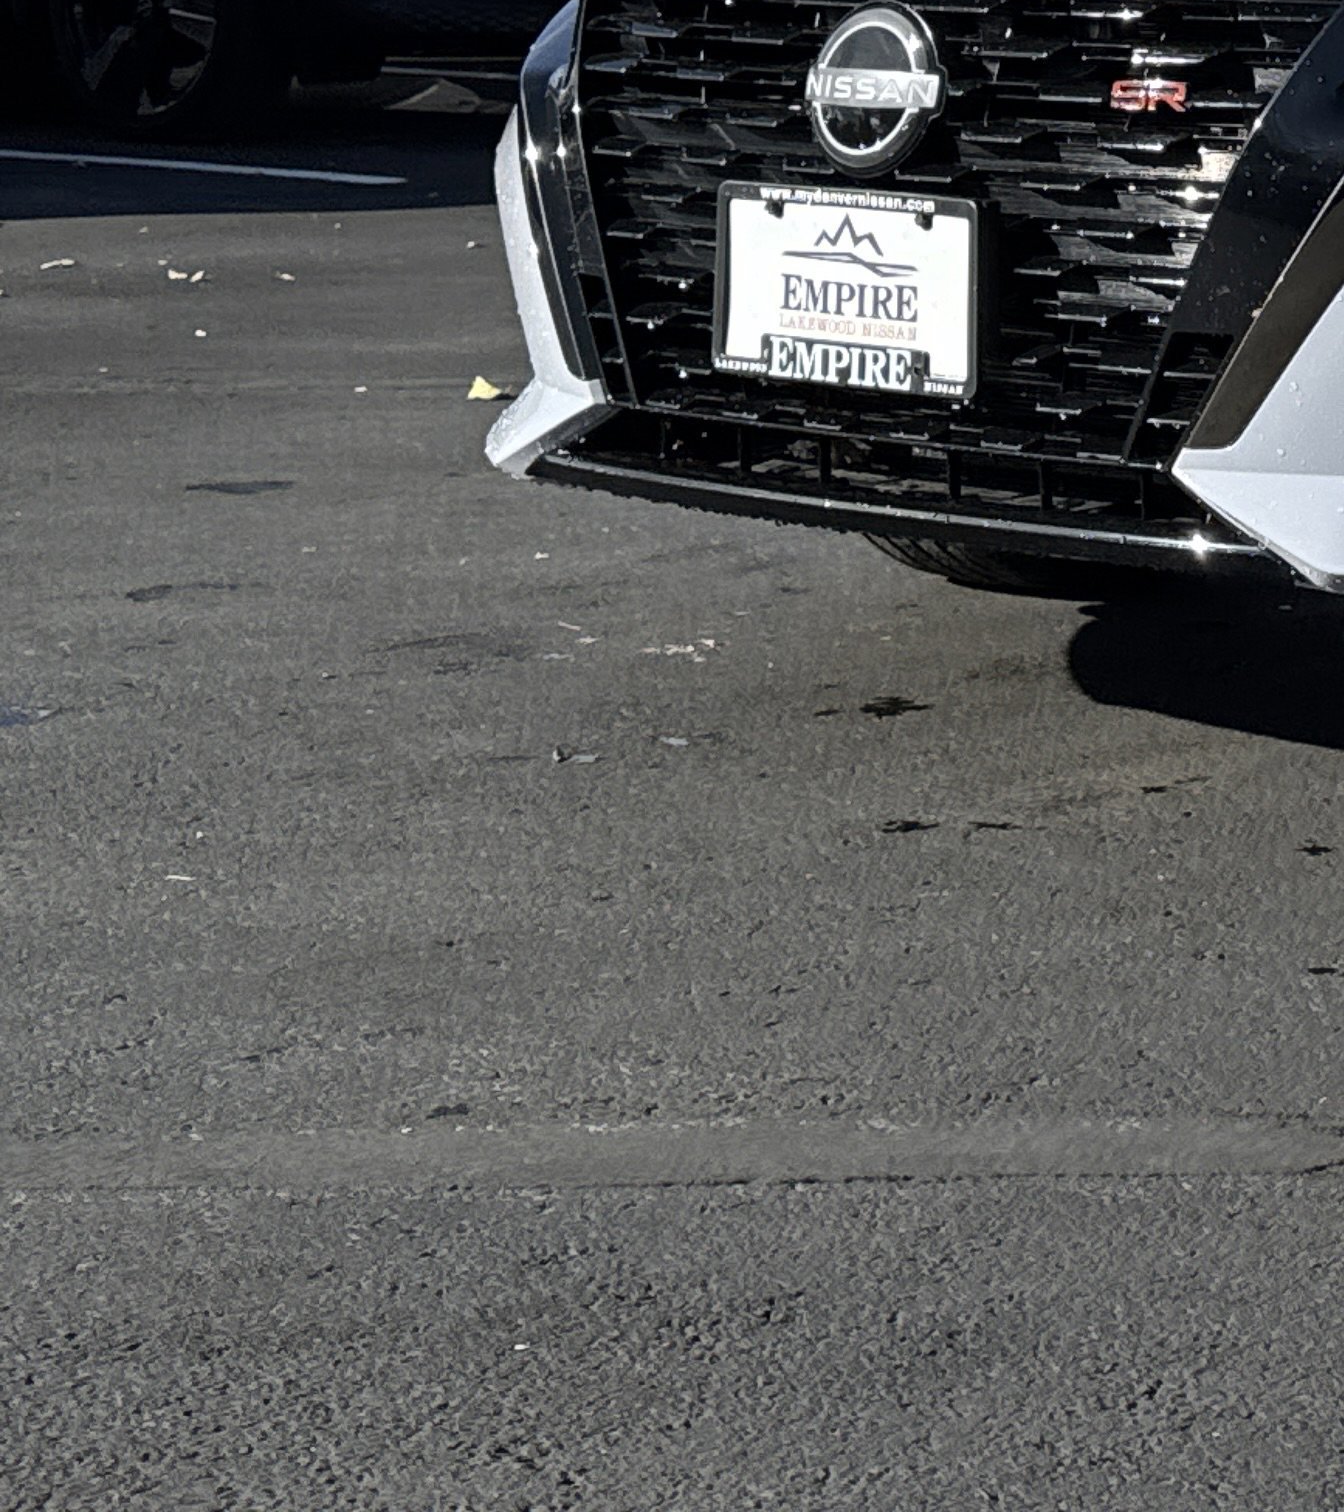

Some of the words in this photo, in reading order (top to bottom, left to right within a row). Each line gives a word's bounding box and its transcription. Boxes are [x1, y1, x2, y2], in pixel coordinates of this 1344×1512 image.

[806, 71, 936, 106] NISSAN
[1110, 78, 1187, 112] SR
[780, 273, 918, 323] EMPIRE
[779, 313, 857, 336] LAKEWOOD
[861, 322, 917, 341] NISSAN
[768, 335, 912, 391] EMPIRE
